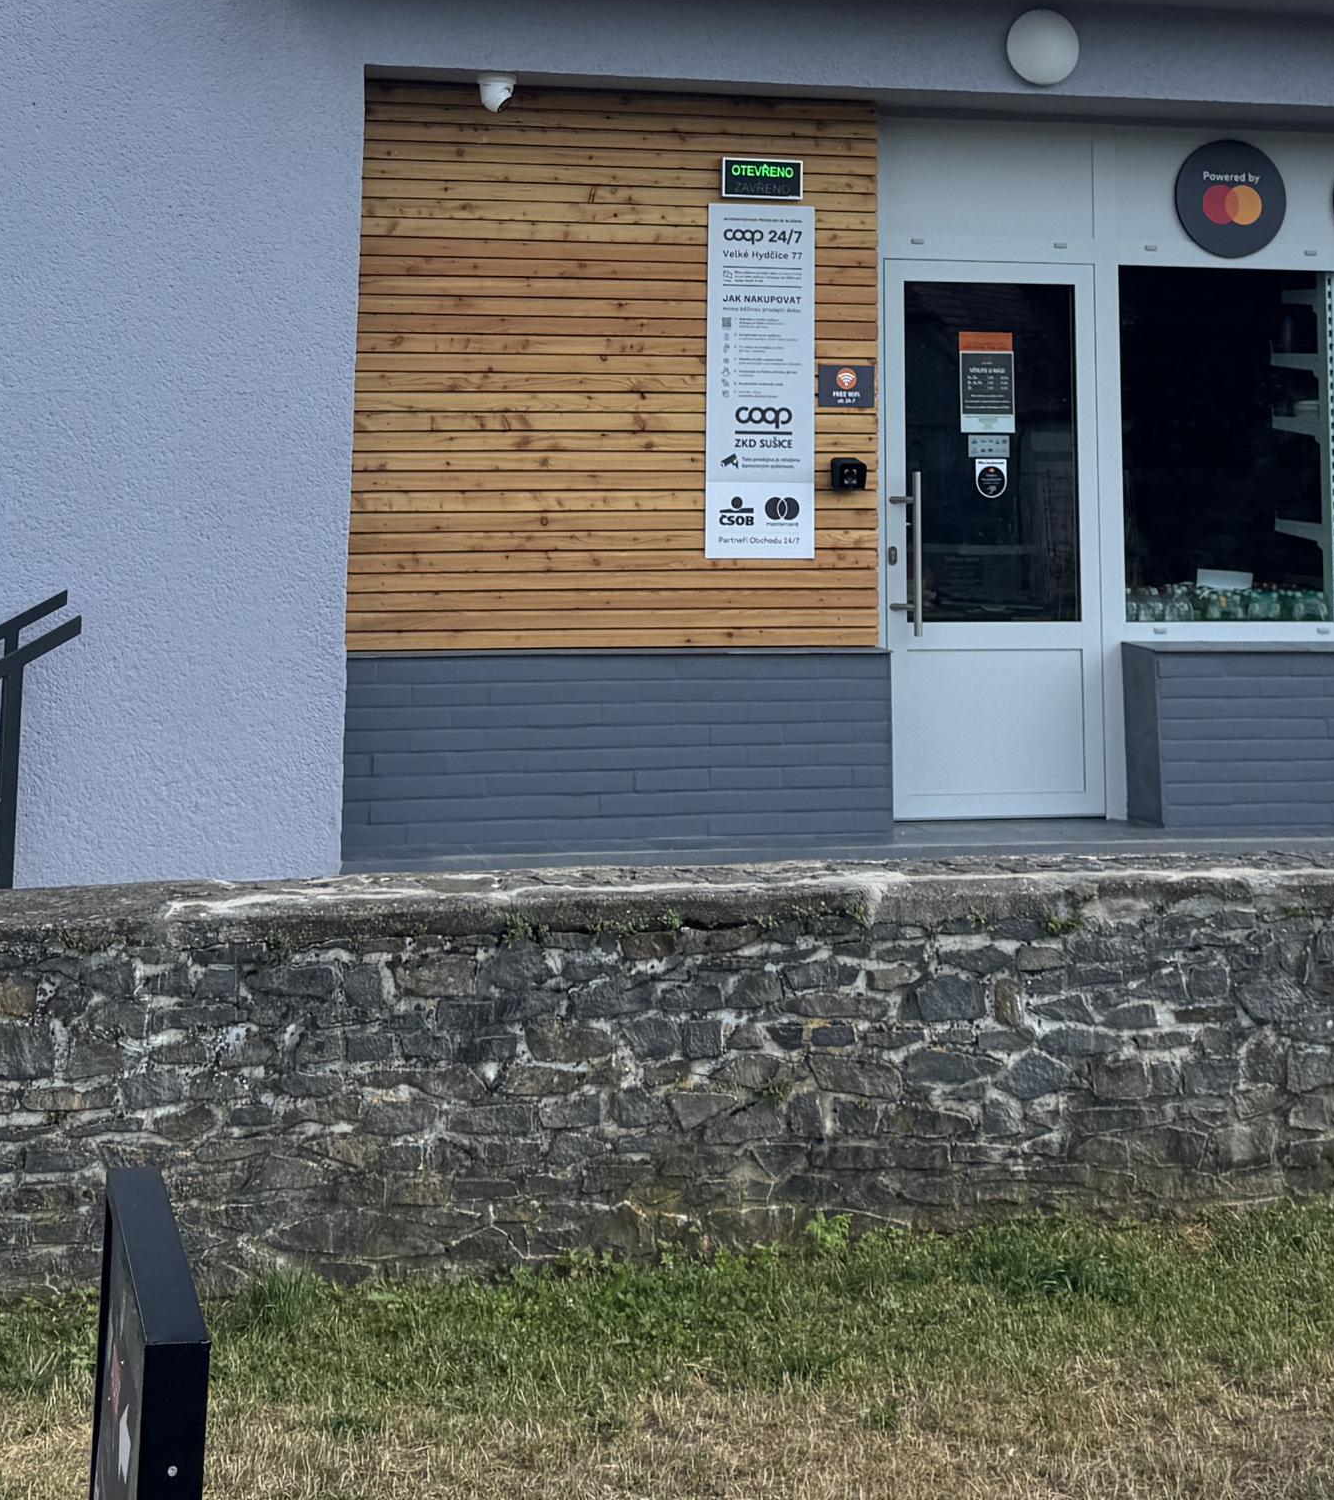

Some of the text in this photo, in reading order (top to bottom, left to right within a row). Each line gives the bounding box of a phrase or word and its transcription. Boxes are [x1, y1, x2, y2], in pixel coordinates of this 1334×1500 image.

[731, 164, 794, 178] OTEVŘENO
[1202, 171, 1261, 184] Powered by
[734, 182, 791, 194] ZAVŘENO
[723, 228, 803, 245] coop 24/7
[723, 249, 803, 260] Velké Hydčice 77
[723, 294, 802, 304] JAK NAKUPOVAT
[735, 406, 793, 429] coop
[734, 436, 793, 448] ZKD SUŠICE
[719, 514, 754, 526] ČSOB
